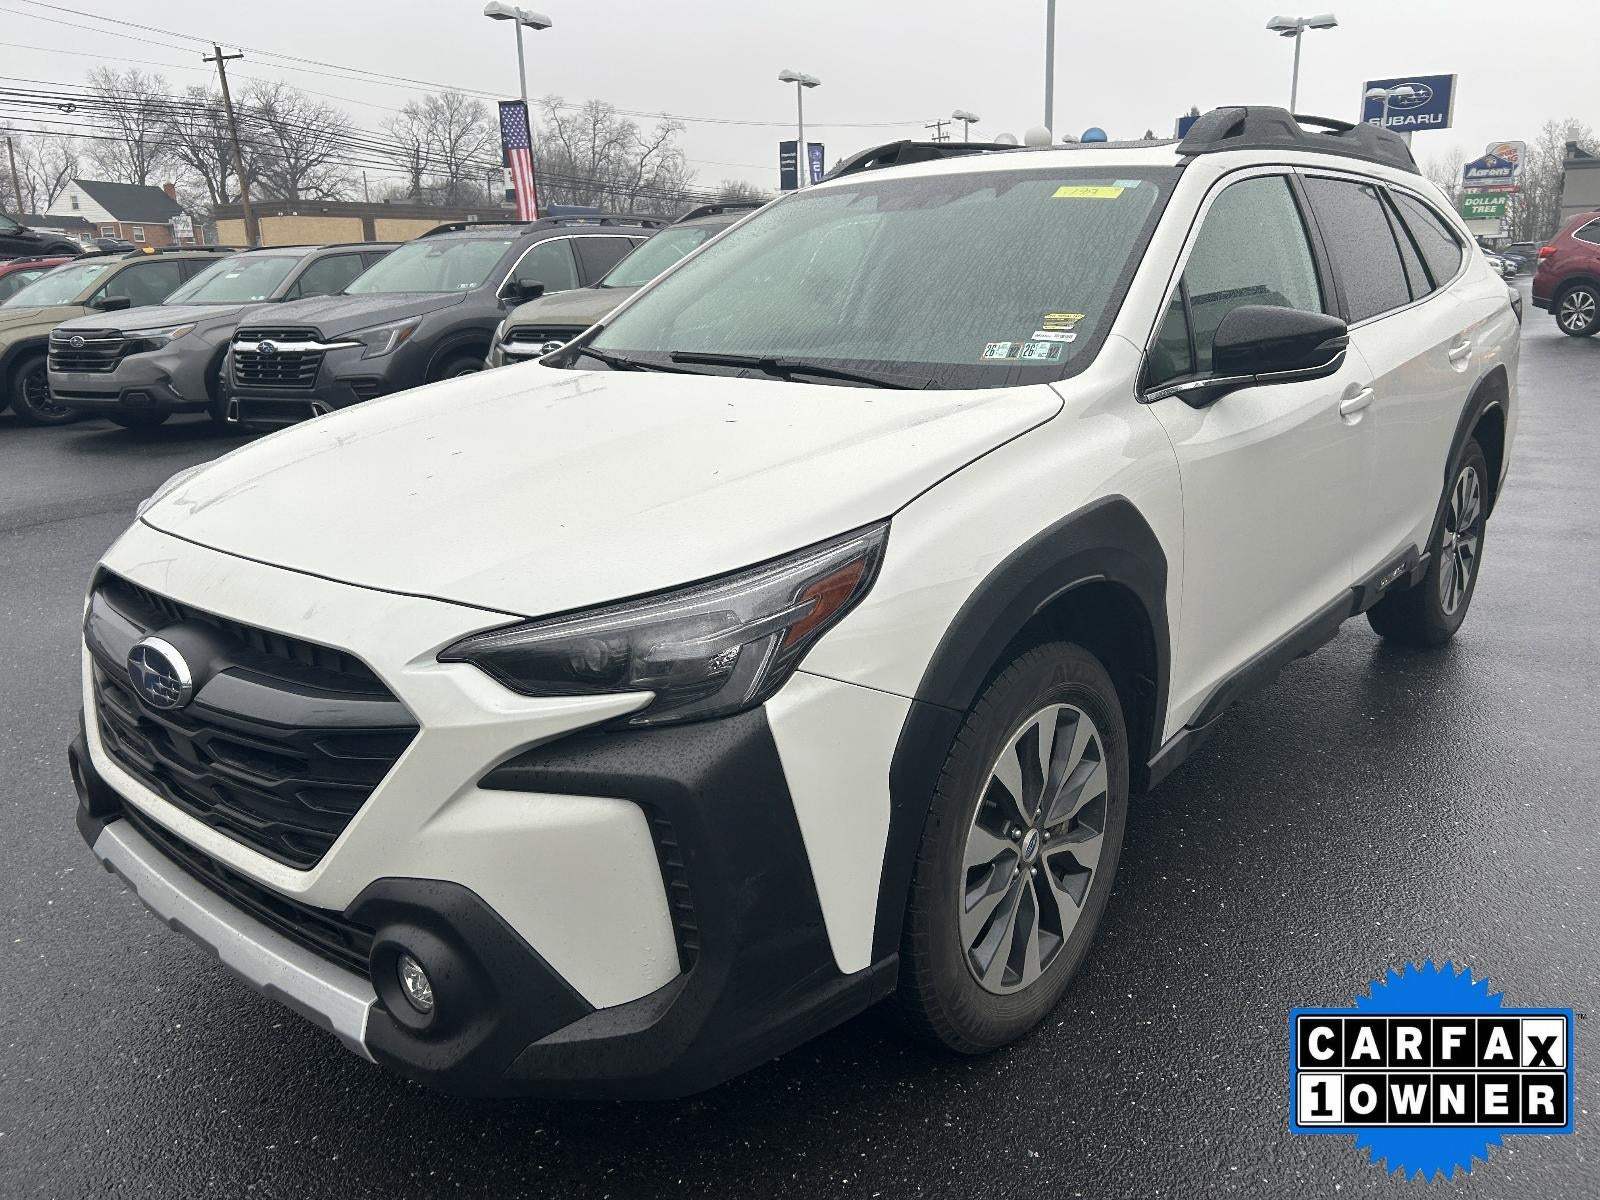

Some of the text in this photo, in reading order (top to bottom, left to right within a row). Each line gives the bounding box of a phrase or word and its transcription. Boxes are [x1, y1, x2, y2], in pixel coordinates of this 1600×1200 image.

[1368, 113, 1443, 127] SUBARU
[1464, 197, 1506, 206] DOLLAR
[1472, 205, 1498, 214] TREE
[1022, 344, 1036, 357] 26
